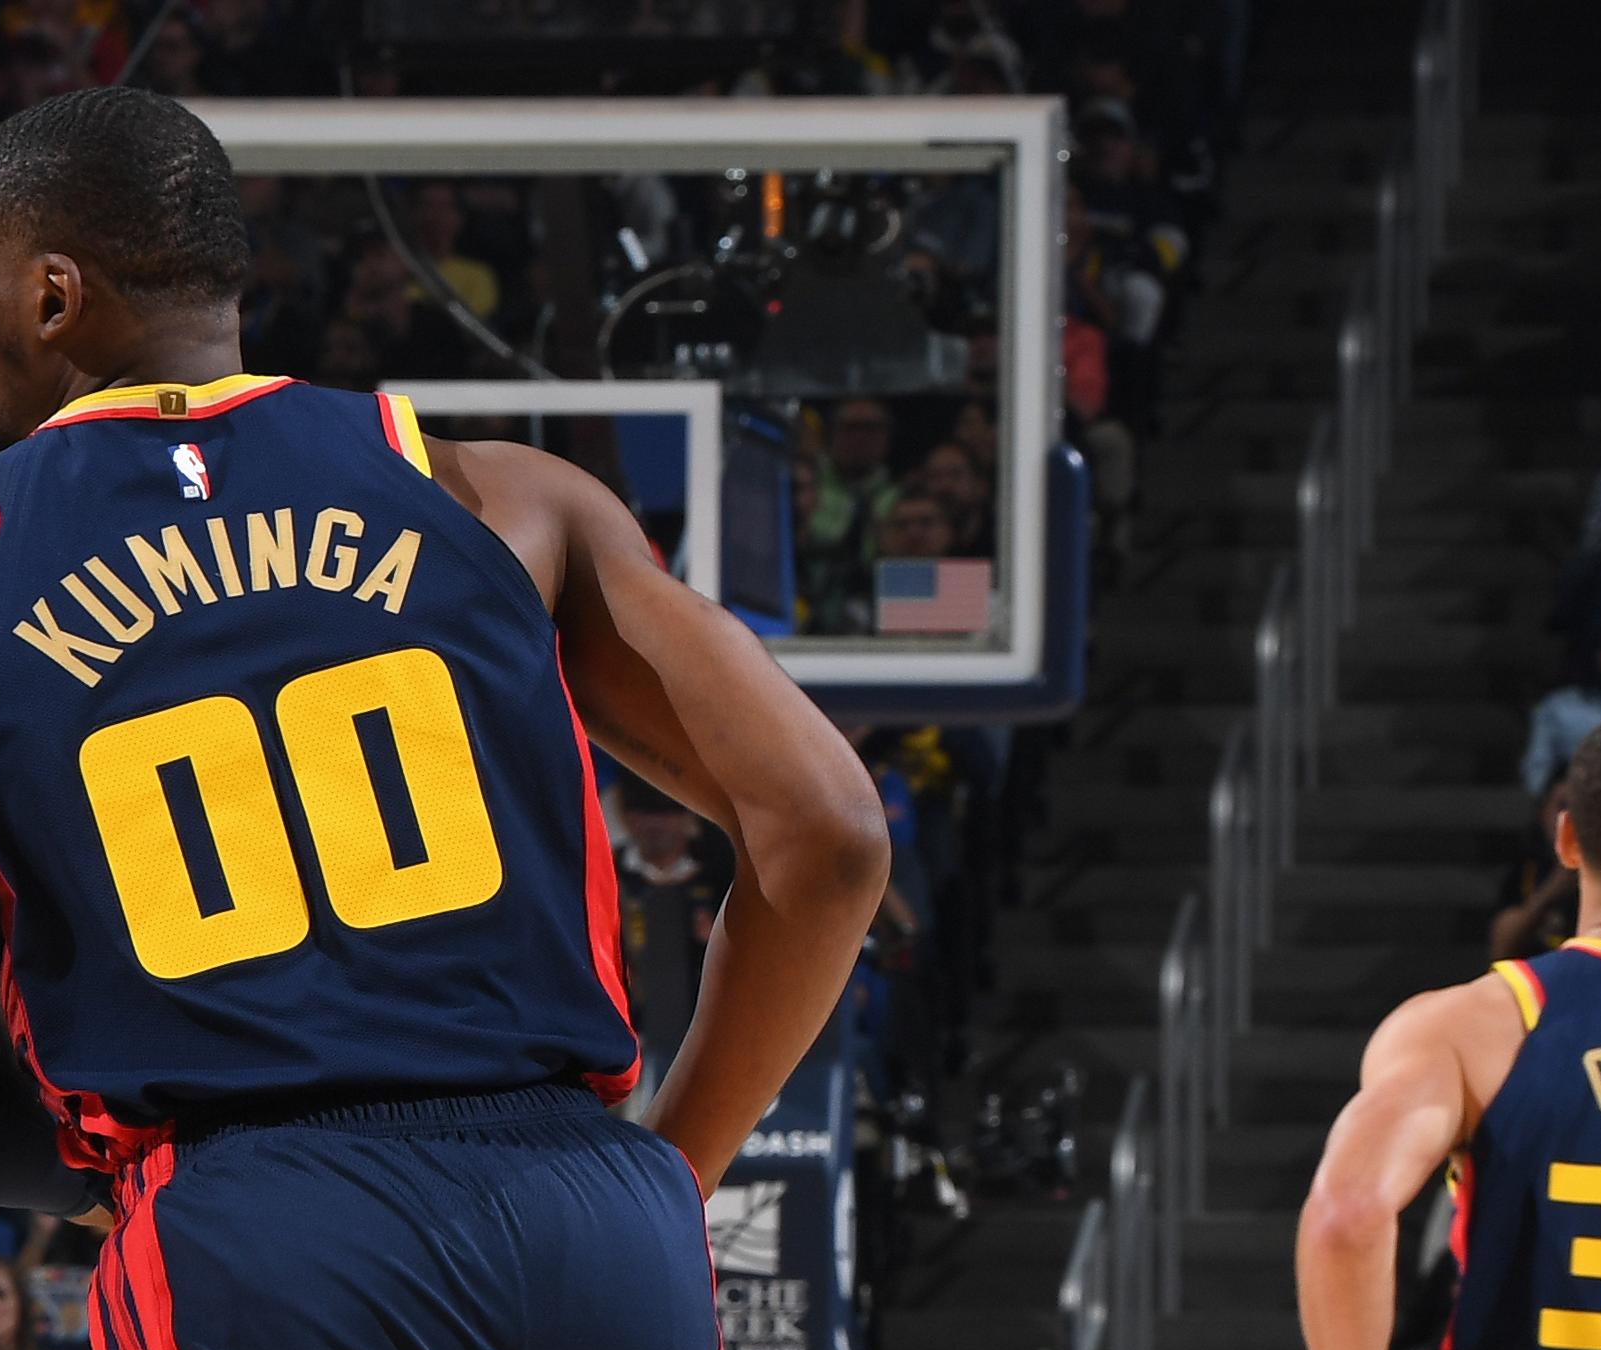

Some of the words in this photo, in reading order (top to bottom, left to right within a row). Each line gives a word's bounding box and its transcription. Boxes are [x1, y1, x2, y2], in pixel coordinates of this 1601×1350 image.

[169, 394, 177, 411] 7
[13, 507, 422, 688] KUMINGA
[79, 648, 502, 979] 00
